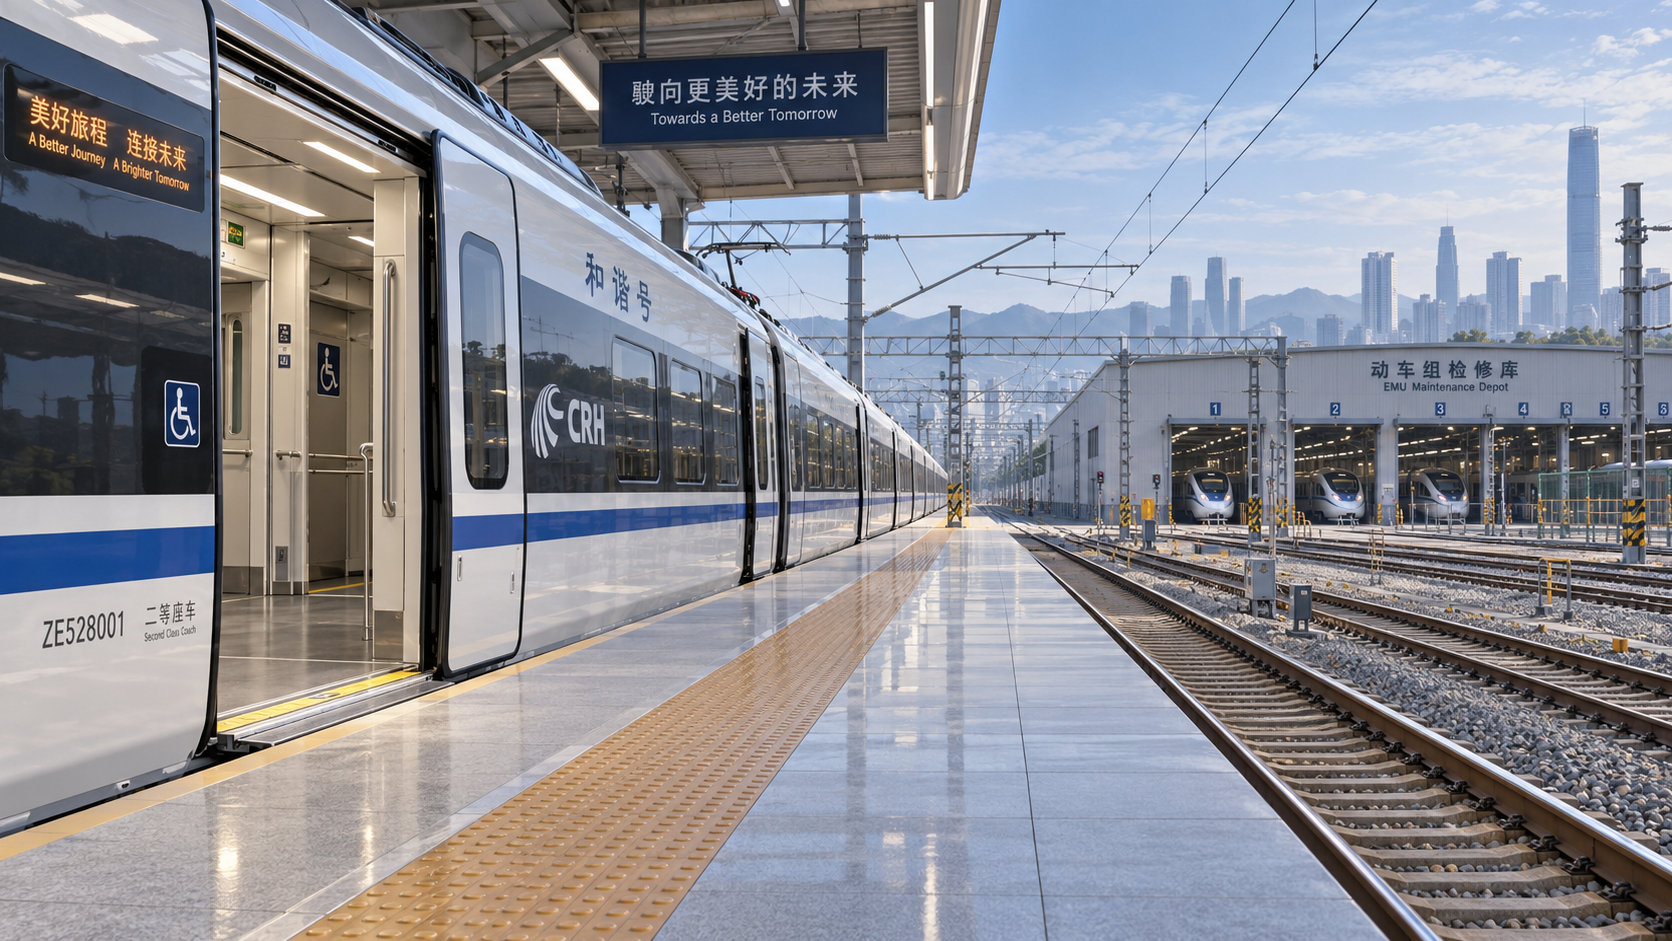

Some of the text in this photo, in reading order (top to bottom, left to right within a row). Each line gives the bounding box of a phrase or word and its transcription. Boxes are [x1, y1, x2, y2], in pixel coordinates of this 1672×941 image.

[651, 107, 838, 126] Towards a Better Tomorrow
[30, 95, 187, 172] 美好旅程 连接未来
[28, 131, 190, 192] A Better Journey A Brighter Tomorrow
[585, 252, 651, 322] 和谐号
[1371, 360, 1519, 379] 动车组检修库
[1383, 381, 1509, 394] EMU Maintenance Depot
[1212, 403, 1218, 415] 1
[1332, 403, 1340, 415] 2
[1437, 403, 1444, 415] 3
[1519, 403, 1528, 414] 4
[1602, 403, 1609, 415] 5
[567, 398, 606, 446] CRH
[145, 600, 196, 625] 二等座车
[42, 610, 125, 649] ZE528001
[144, 629, 165, 642] Second
